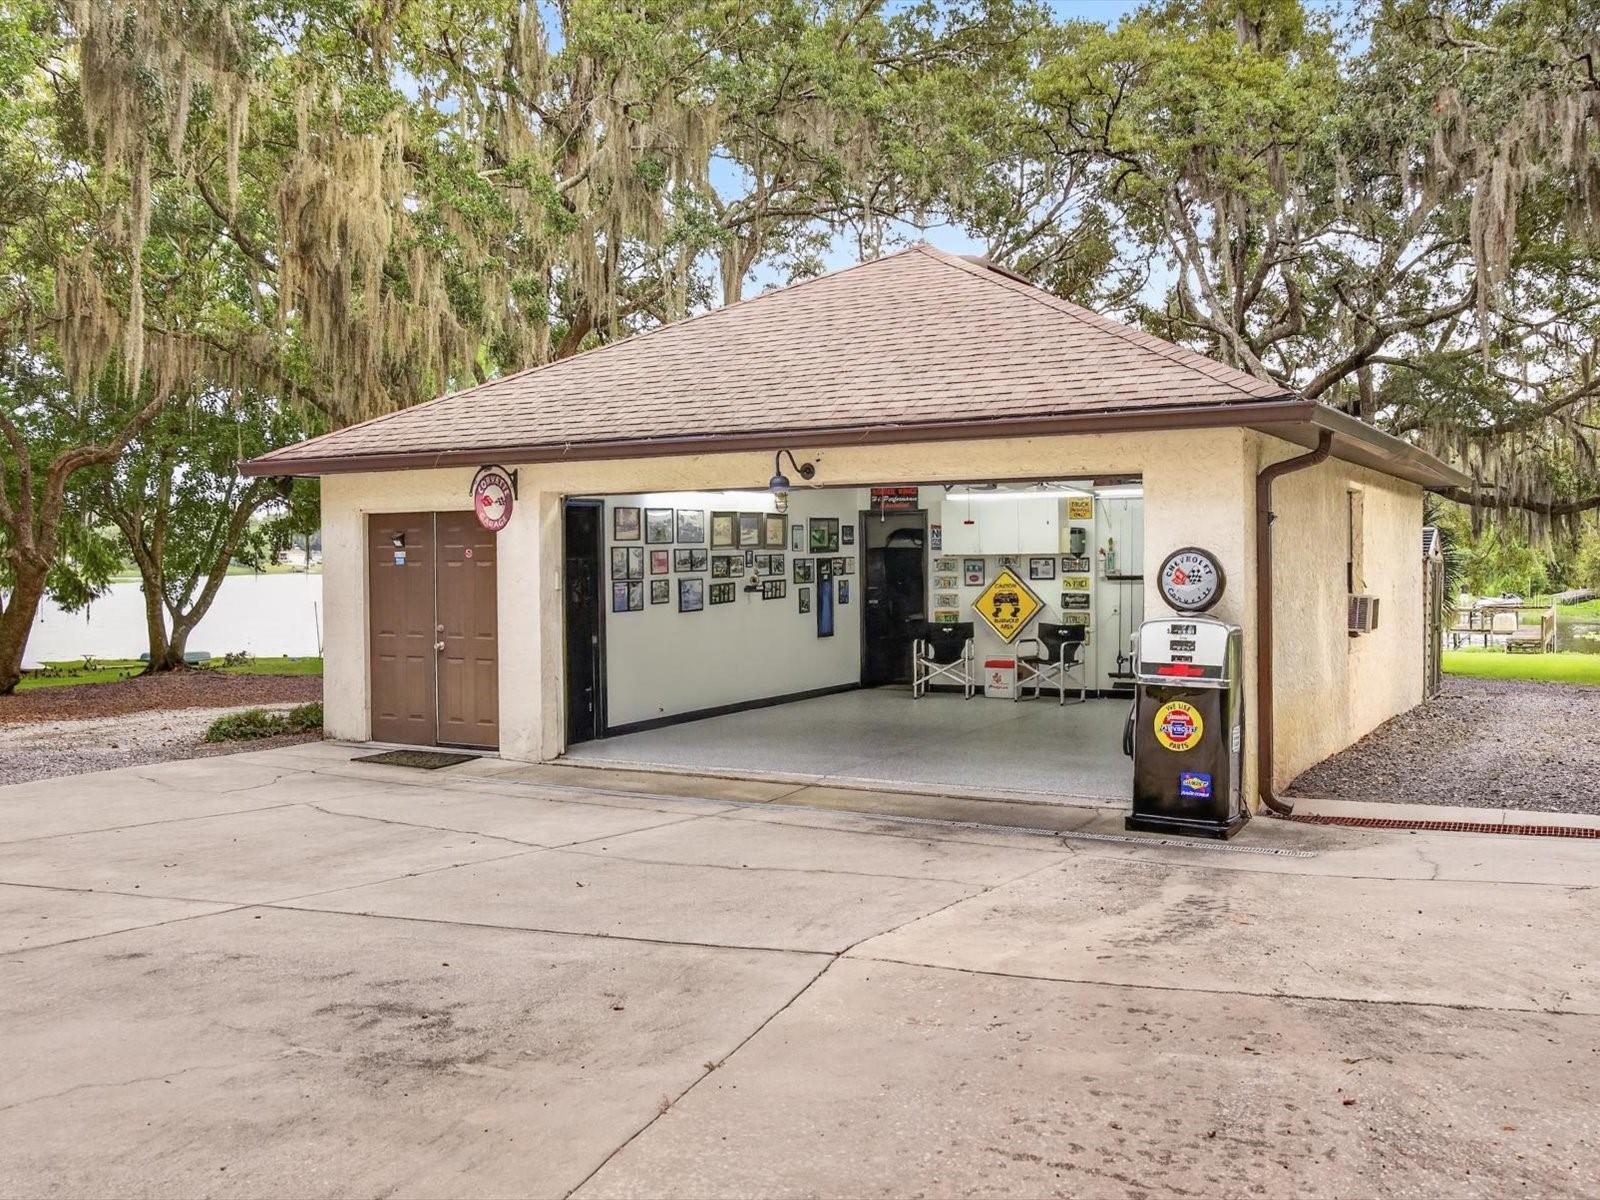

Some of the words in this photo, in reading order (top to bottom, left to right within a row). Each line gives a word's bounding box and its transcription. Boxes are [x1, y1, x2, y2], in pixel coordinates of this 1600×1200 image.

[478, 475, 510, 495] CORVETTE
[1166, 556, 1213, 577] CHEVROLET
[1168, 742, 1190, 750] PARTS
